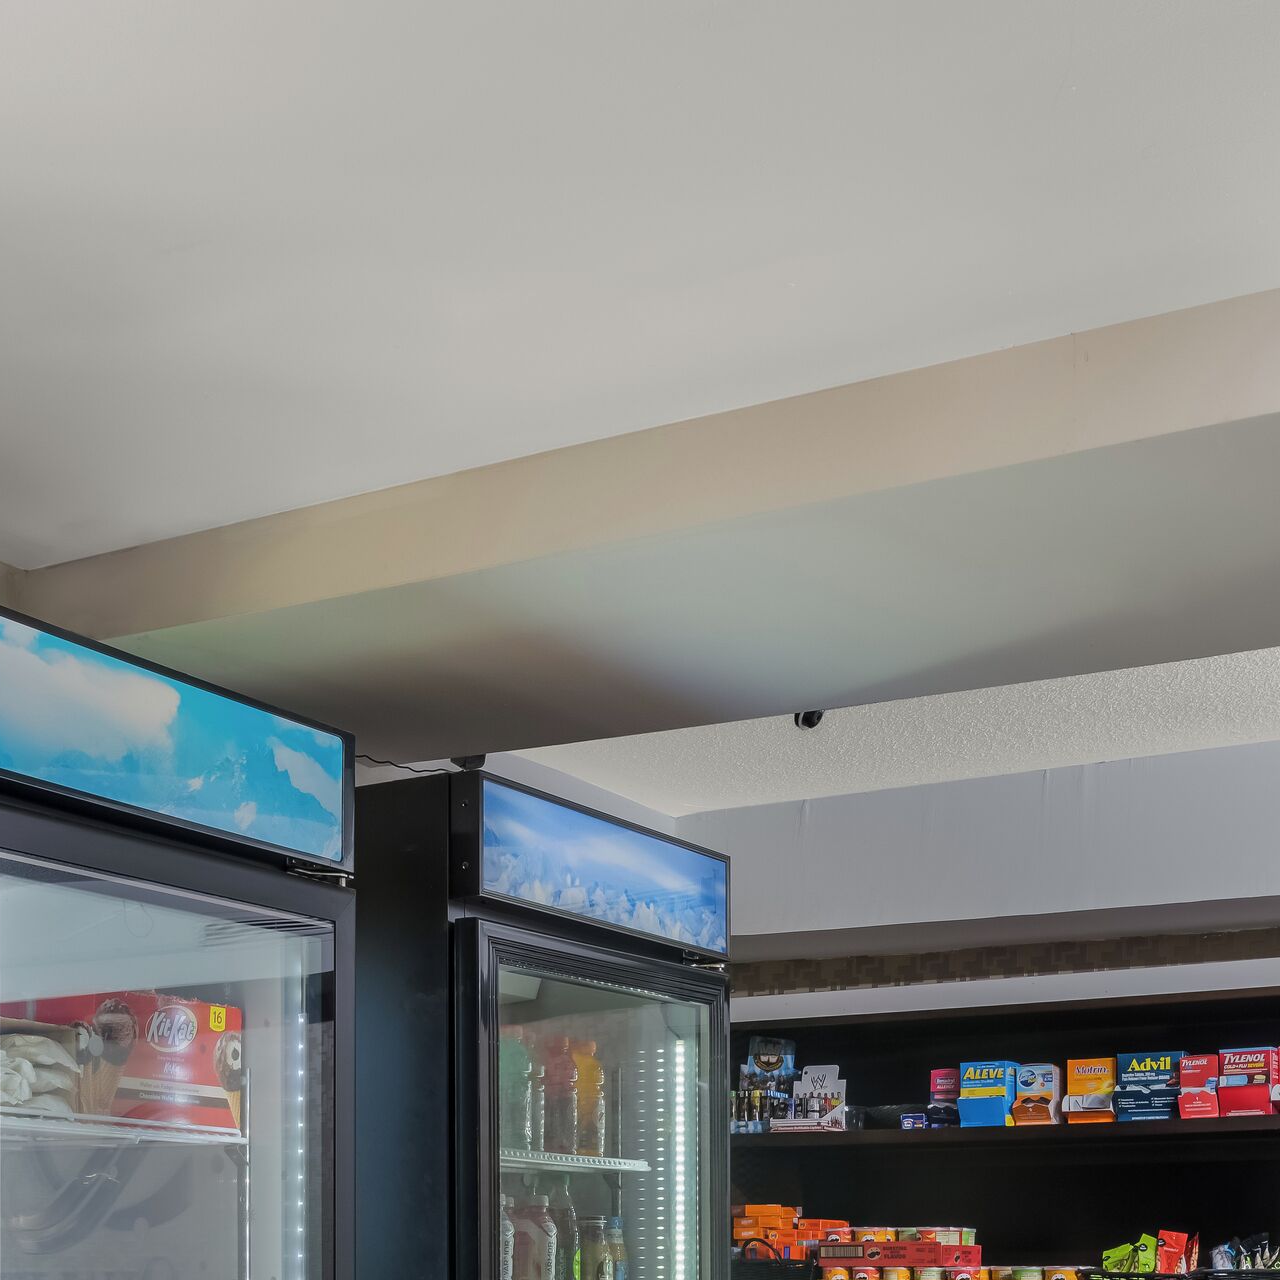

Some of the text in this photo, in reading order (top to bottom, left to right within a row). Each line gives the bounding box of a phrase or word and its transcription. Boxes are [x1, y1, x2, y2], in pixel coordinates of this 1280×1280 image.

[213, 1010, 223, 1025] 16
[1127, 1056, 1171, 1072] Advil
[1223, 1054, 1266, 1064] TYLENOL
[963, 1067, 1005, 1081] ALEVE
